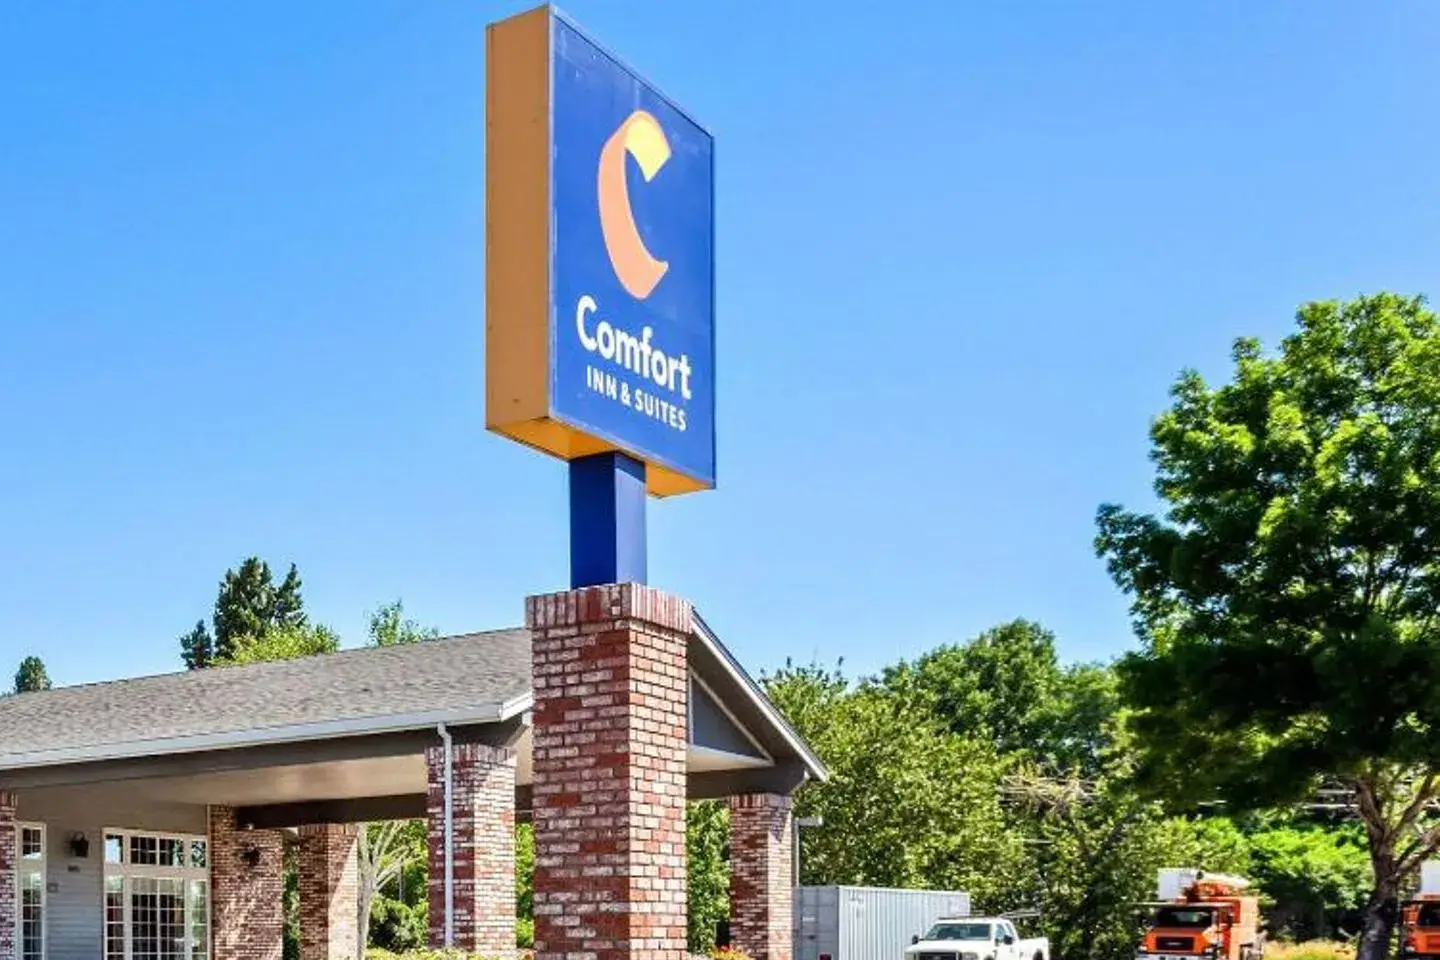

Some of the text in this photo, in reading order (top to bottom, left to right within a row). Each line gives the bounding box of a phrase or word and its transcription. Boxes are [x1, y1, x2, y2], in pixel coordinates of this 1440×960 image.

[576, 295, 692, 400] Comfort
[586, 364, 687, 432] INN & SUITES
